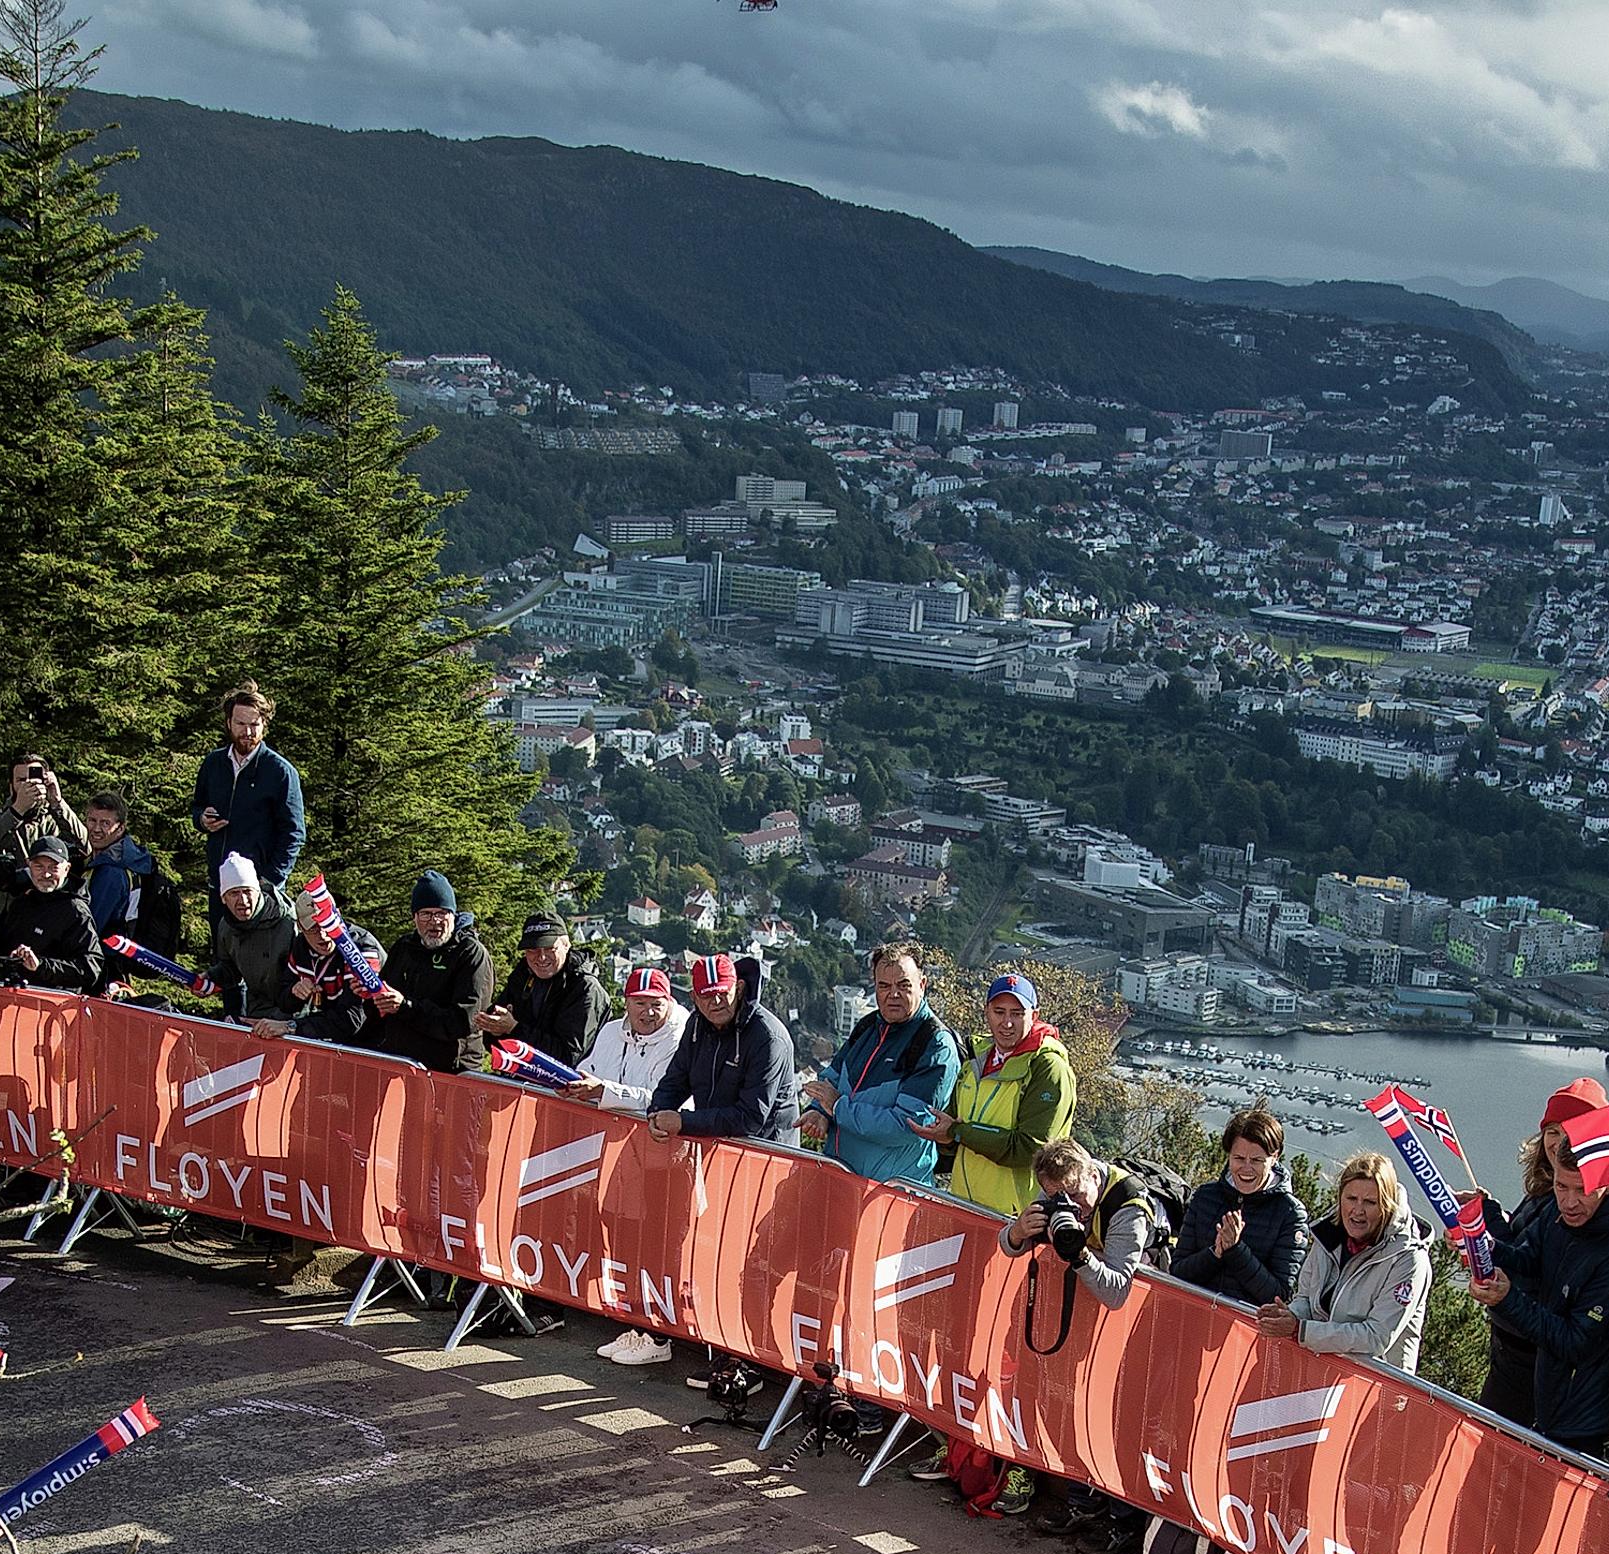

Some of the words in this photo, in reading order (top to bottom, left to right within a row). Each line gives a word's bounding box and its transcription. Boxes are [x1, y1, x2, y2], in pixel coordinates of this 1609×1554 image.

[116, 1132, 334, 1242] FLØYEN
[441, 1213, 678, 1325] FLØYEN
[791, 1312, 1028, 1451] FLØYEN
